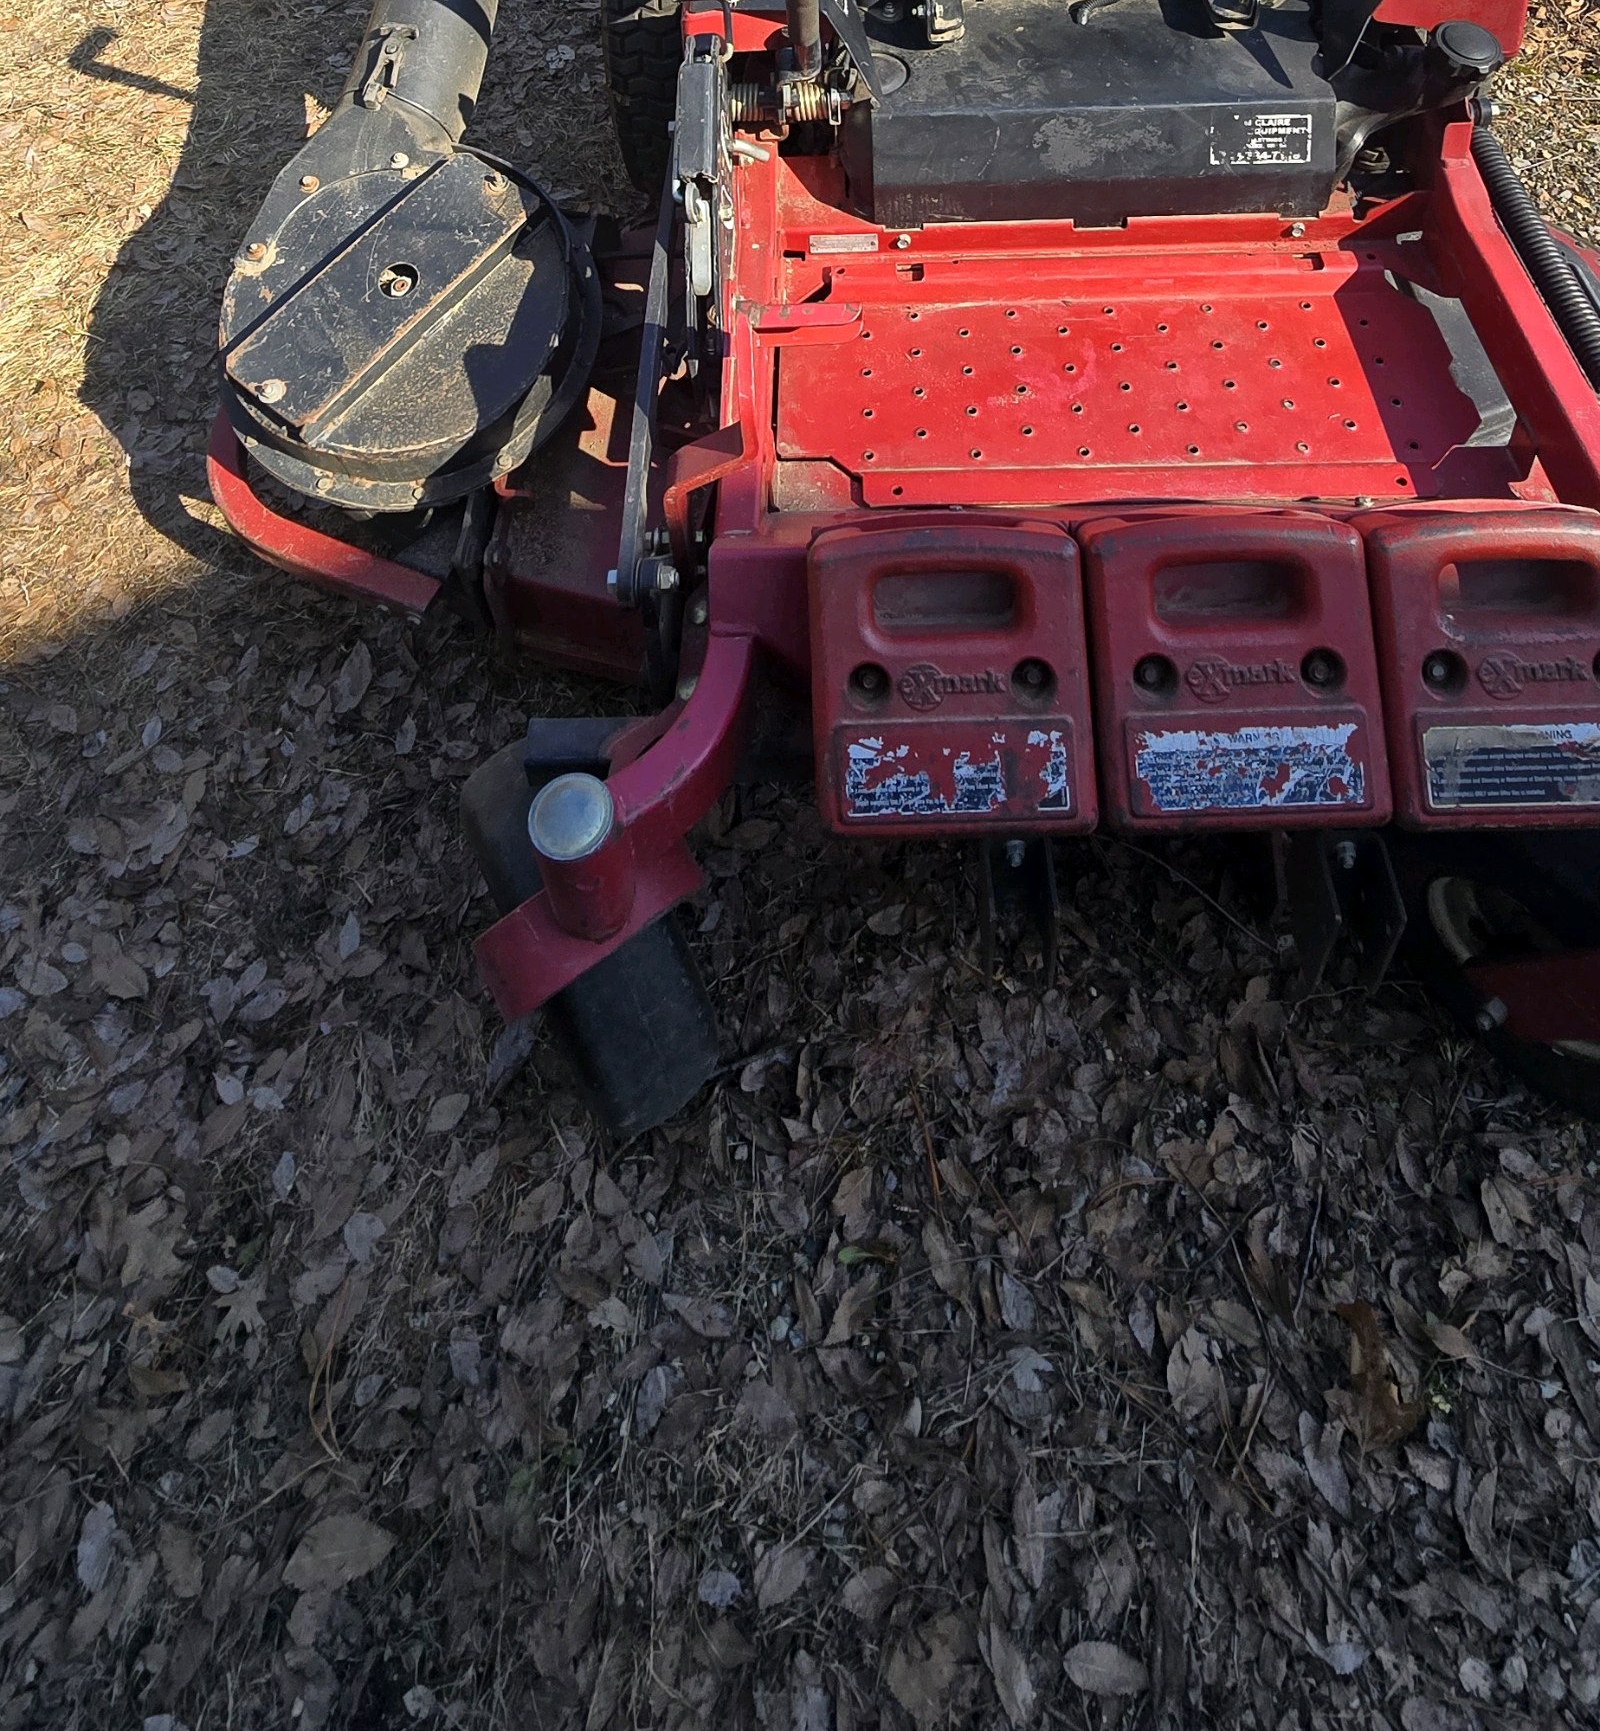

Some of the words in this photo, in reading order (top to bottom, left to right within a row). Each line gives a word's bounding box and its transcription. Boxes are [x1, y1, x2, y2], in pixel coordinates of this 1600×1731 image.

[1247, 127, 1307, 135] QUIPMENT
[1254, 118, 1291, 127] CLAIRE
[901, 668, 1008, 707] eXmark
[1187, 658, 1297, 698] eXmark
[1478, 654, 1589, 695] eXmark
